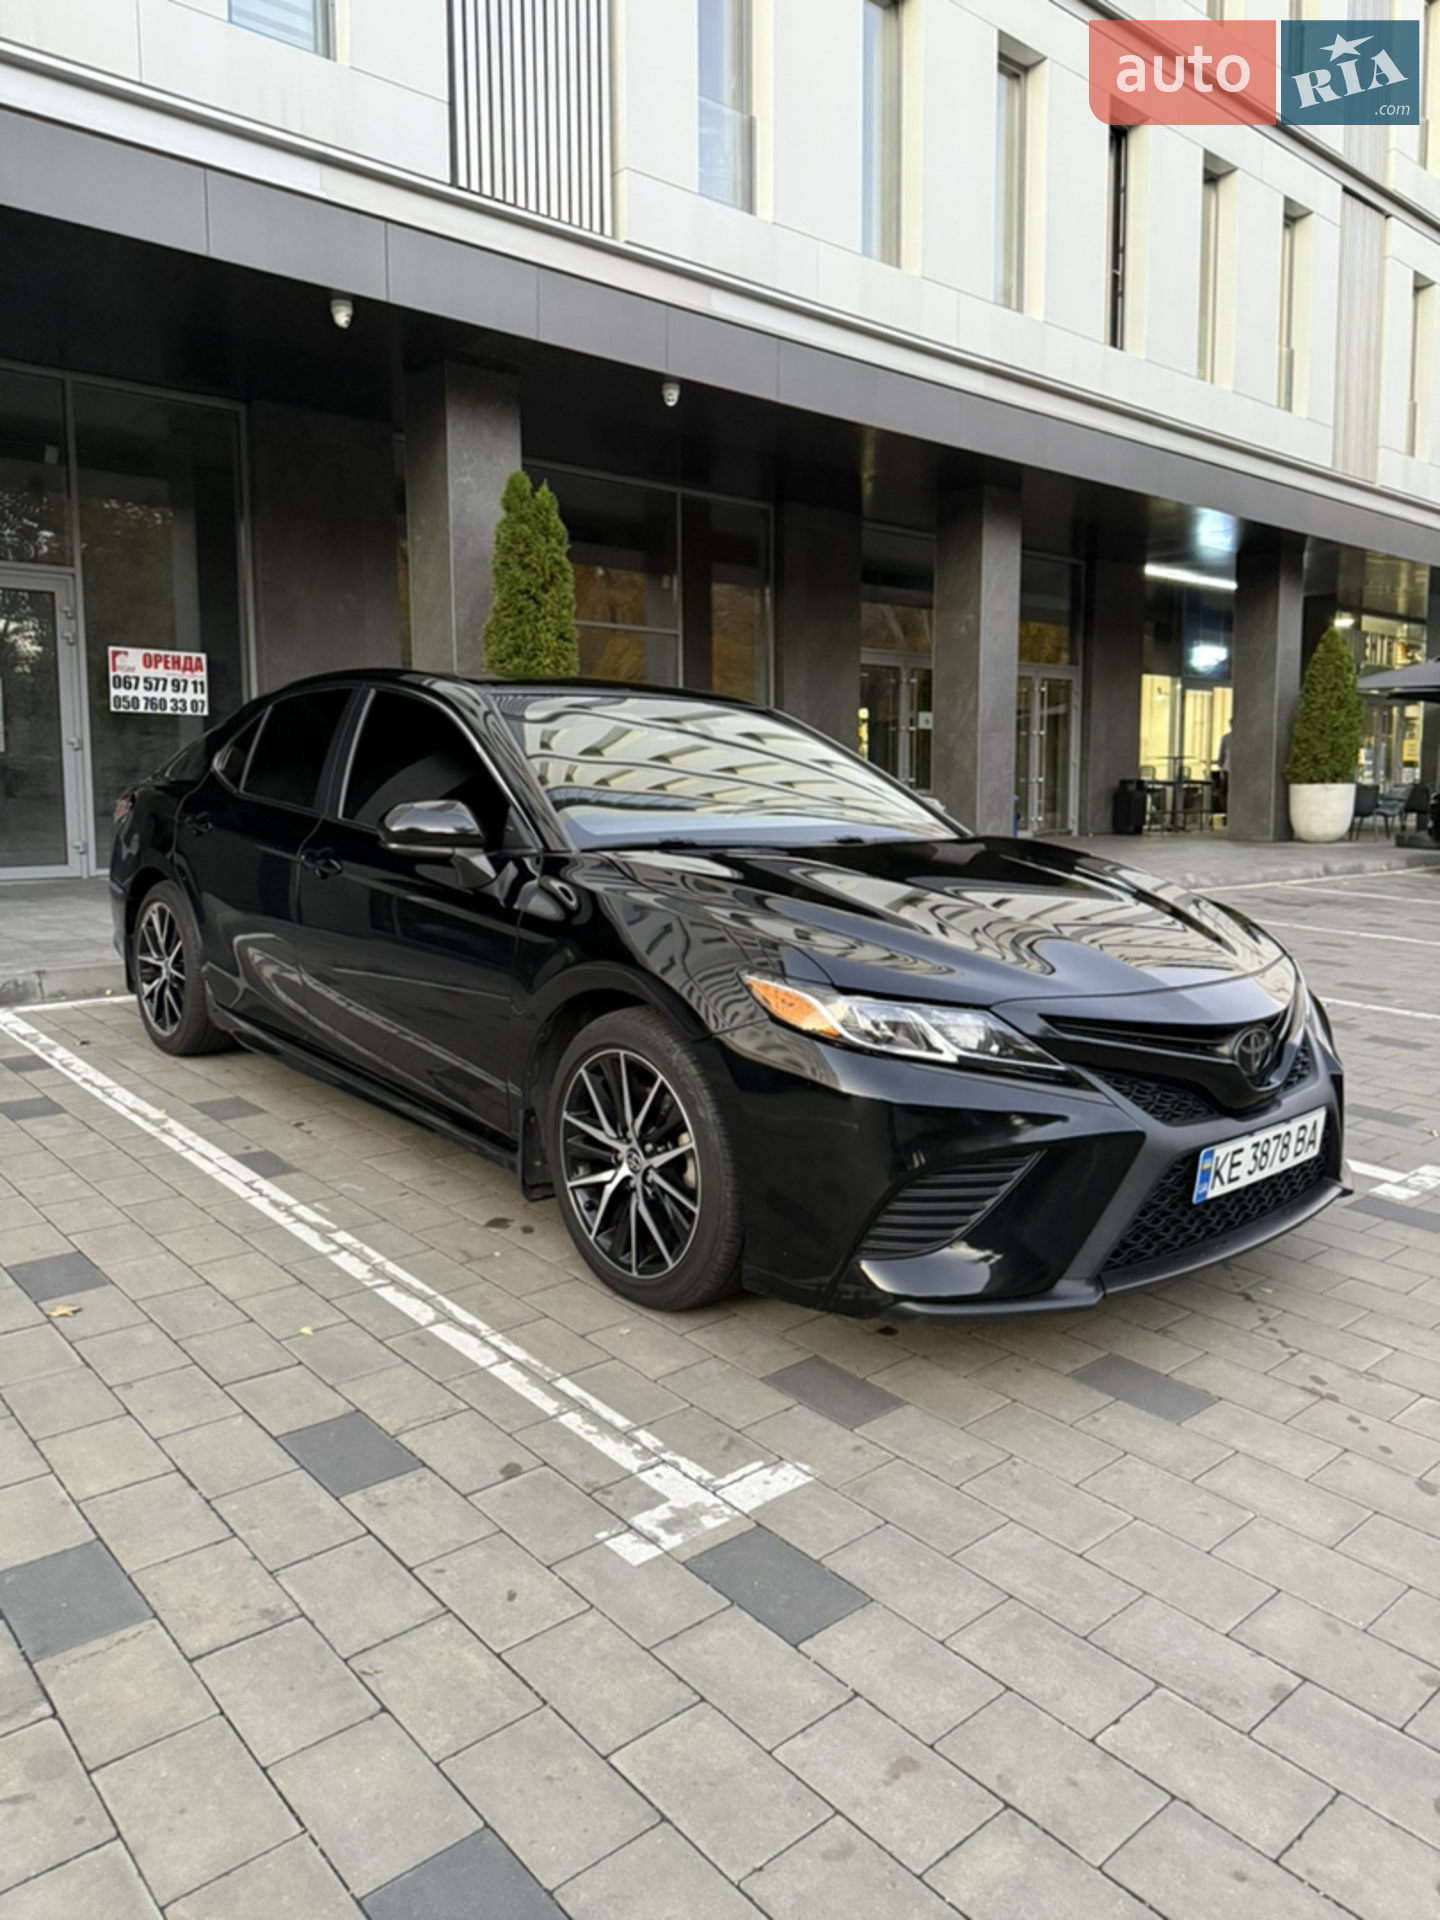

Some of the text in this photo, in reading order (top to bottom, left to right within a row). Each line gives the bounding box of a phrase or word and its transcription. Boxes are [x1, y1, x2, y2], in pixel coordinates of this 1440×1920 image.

[142, 652, 204, 674] ОРЕНДА
[112, 675, 205, 694] 067 577 97 11
[113, 694, 205, 713] 050 760 33 07
[1210, 1119, 1318, 1190] KE 3878 BA
